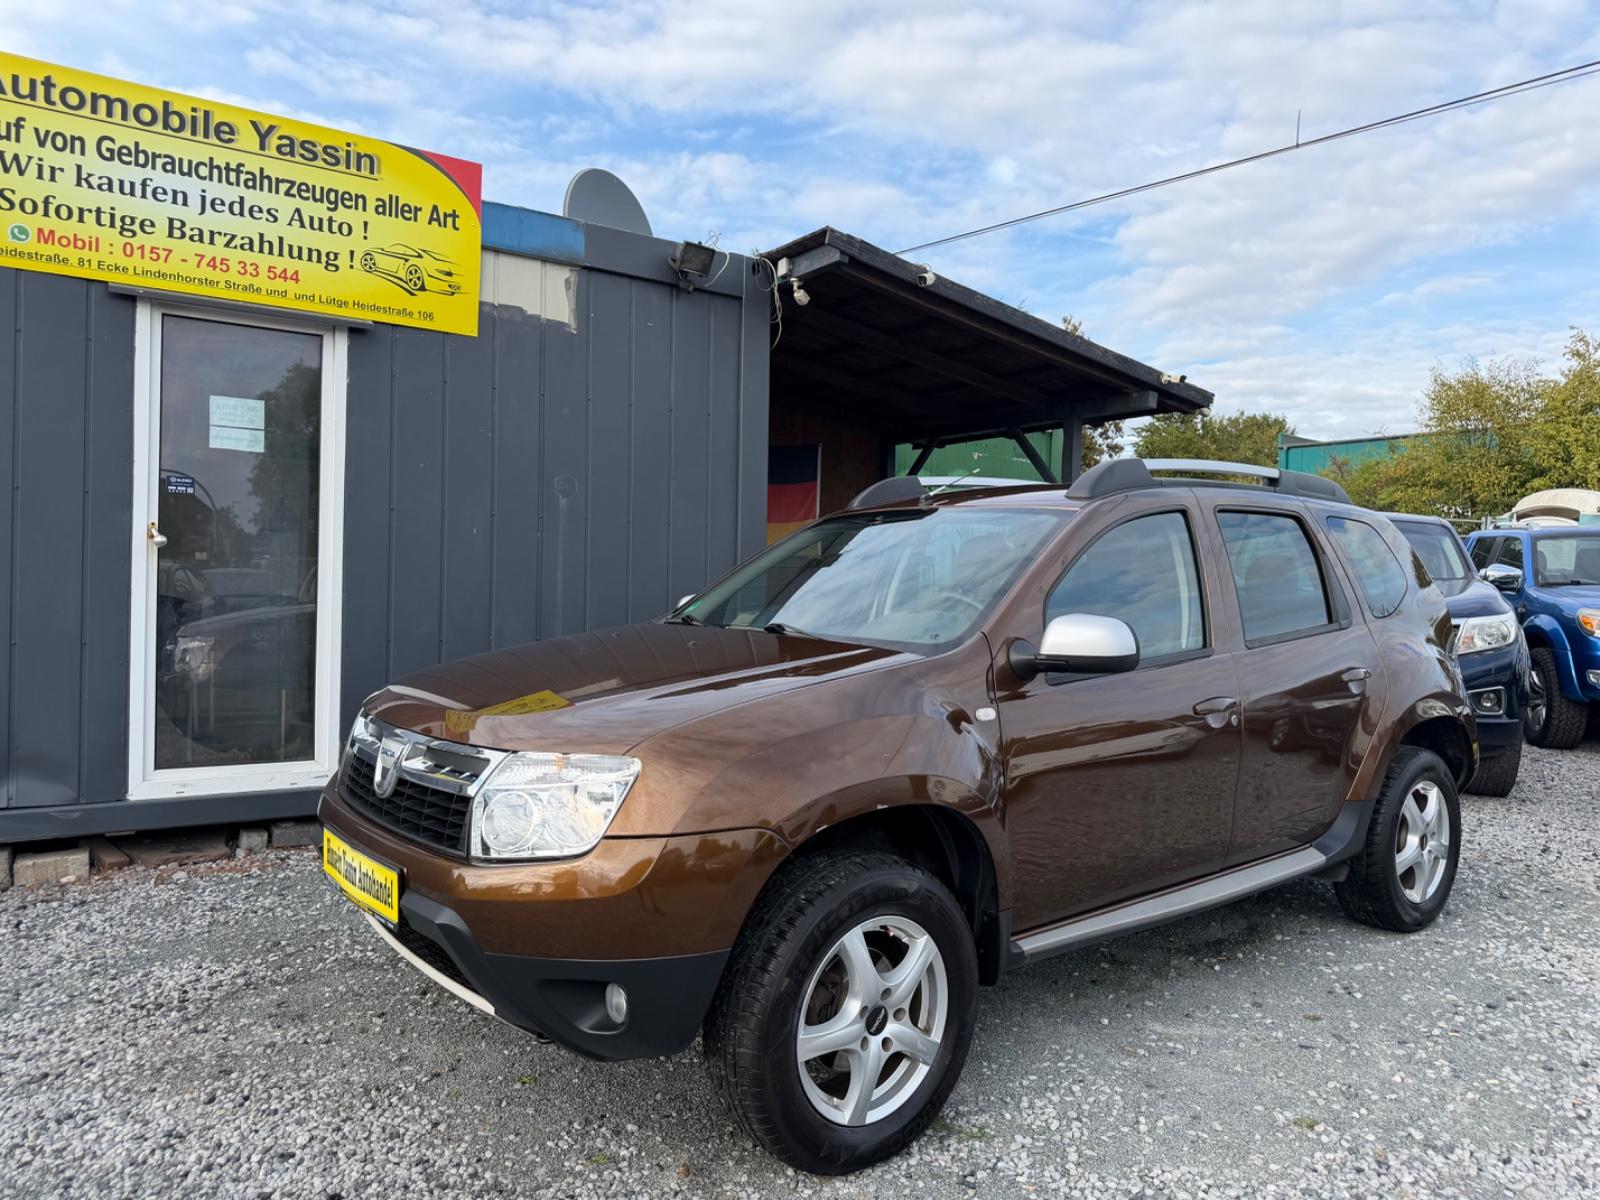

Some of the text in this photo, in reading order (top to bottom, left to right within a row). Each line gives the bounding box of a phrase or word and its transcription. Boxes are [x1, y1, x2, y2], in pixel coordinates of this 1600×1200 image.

[0, 74, 377, 175] utomobile Yassin
[0, 150, 64, 183] Wir
[74, 163, 189, 208] kaufen
[199, 189, 279, 224] jedes
[286, 207, 353, 237] Auto
[33, 127, 86, 156] von
[96, 135, 367, 212] Gebrauchtfahrzeugen
[374, 194, 422, 223] aller
[428, 204, 460, 231] Art
[0, 187, 156, 239] Sofortige
[167, 216, 340, 272] Barzahlung
[36, 227, 100, 253] Mobil
[122, 242, 173, 264] 0157
[194, 253, 231, 273] 745
[237, 260, 260, 278] 33
[267, 265, 301, 285] 544
[78, 257, 92, 269] 81
[97, 260, 129, 274] Ecke
[133, 266, 220, 288] Lindenhorster
[224, 280, 262, 294] Straße
[266, 288, 288, 298] und
[294, 292, 316, 302] und
[319, 294, 349, 309] Lütge
[352, 300, 414, 317] Heidestraße
[417, 310, 435, 320] 106
